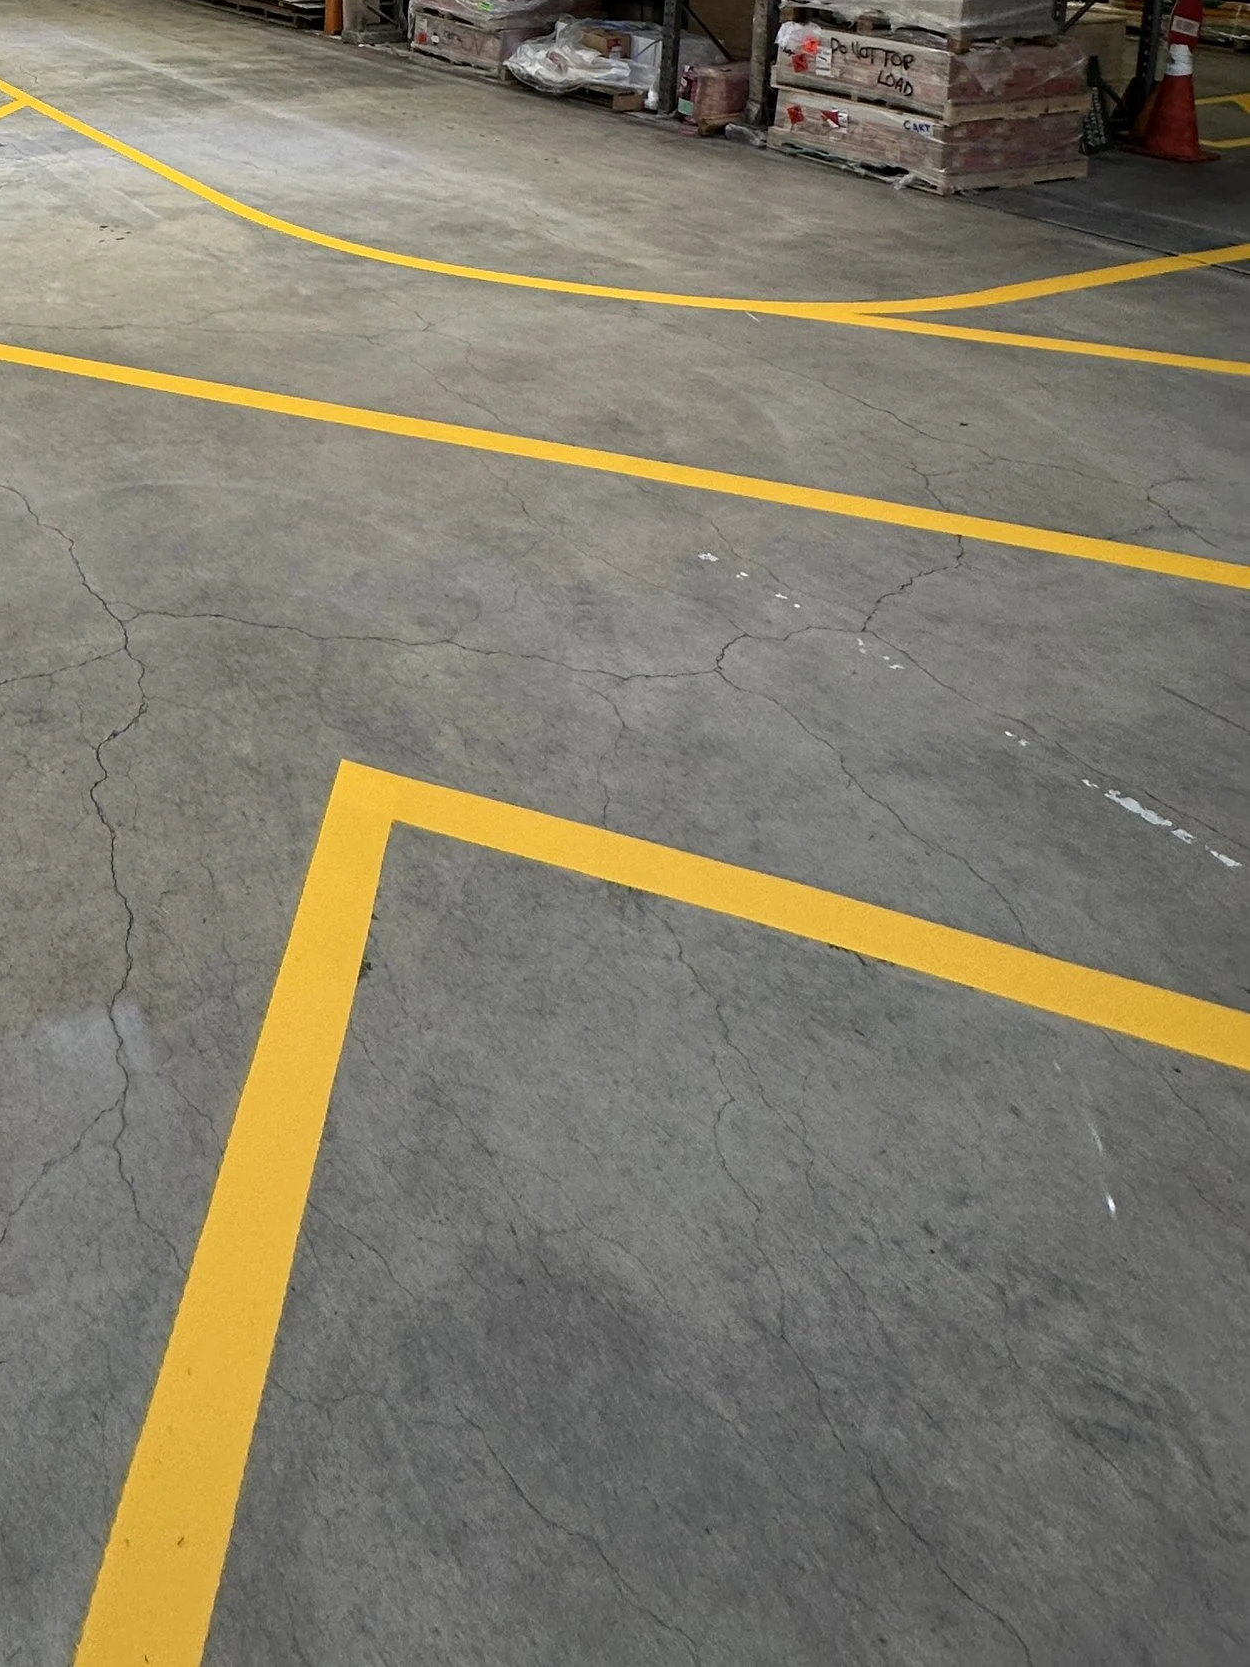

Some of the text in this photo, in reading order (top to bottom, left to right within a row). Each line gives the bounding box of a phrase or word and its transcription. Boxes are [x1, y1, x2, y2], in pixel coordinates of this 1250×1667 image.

[877, 48, 915, 71] TOP
[877, 70, 914, 97] LOAD
[903, 119, 931, 134] CART
